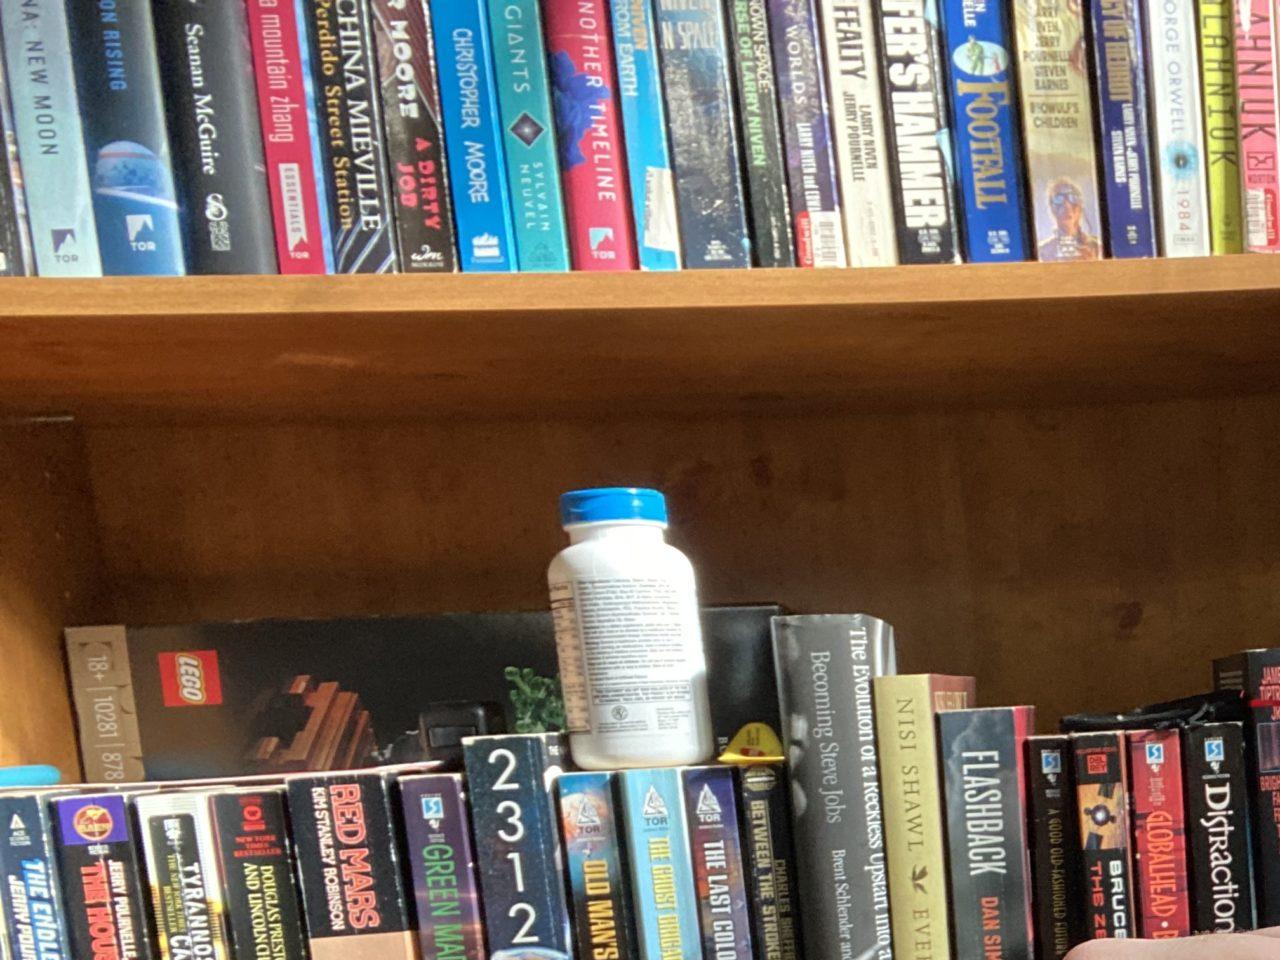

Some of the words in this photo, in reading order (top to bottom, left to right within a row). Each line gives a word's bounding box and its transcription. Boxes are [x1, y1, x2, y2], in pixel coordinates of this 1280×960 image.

[25, 41, 49, 85] NEW
[103, 30, 127, 91] RISING
[185, 23, 205, 88] Seanan
[260, 14, 290, 89] mountain
[335, 0, 366, 90] CHINA
[390, 20, 419, 118] MOORE
[504, 5, 531, 94] GIANTS
[577, 1, 605, 88] NOTHER
[786, 24, 807, 105] WORLDS
[834, 6, 867, 80] FEALTY
[453, 28, 481, 129] CHRISTOPHER
[619, 44, 639, 97] EARTH
[741, 61, 759, 115] LARRY
[1168, 61, 1184, 133] ORWELL
[33, 95, 58, 155] MOON
[269, 96, 299, 143] zhang
[325, 85, 342, 147] Street
[842, 91, 858, 122] JERRY
[859, 104, 873, 137] LARRY
[1033, 117, 1079, 129] CHILDREN
[194, 93, 220, 175] McGuire
[588, 103, 617, 202] TIMELINE
[749, 117, 767, 167] NIVEN
[797, 123, 813, 148] LARRY
[847, 125, 865, 182] POURNELLE
[865, 141, 878, 169] NIVEN
[891, 91, 947, 228] HAMMER
[956, 78, 1010, 210] FOOTFALL
[347, 100, 381, 231] MIÉVILLE
[464, 141, 490, 204] MOORE
[801, 149, 817, 173] NIVEN
[284, 167, 302, 234] ESSENTIALS
[333, 157, 353, 229] Station
[418, 160, 441, 230] DIRTY
[520, 164, 536, 229] NEUVEL
[532, 161, 549, 231] SYLVAIN
[1177, 190, 1191, 231] 1984
[1266, 193, 1276, 240] Goodwill
[800, 218, 812, 265] Goodwill
[88, 656, 108, 681] 18+
[849, 627, 869, 660] The
[177, 655, 203, 703] LEGO
[810, 651, 836, 738] Becoming
[94, 696, 117, 738] 10281
[896, 698, 917, 751] NISI
[102, 753, 125, 781] 878
[819, 742, 840, 785] Steve
[311, 787, 327, 809] KIM
[330, 783, 366, 845] RED
[699, 813, 721, 822] TOR
[819, 787, 846, 824] Jobs
[901, 766, 925, 852] SHAWL
[961, 750, 1008, 876] FLASHBACK
[314, 811, 336, 864] STANLEY
[647, 837, 670, 861] THE
[703, 840, 725, 872] THE
[750, 800, 772, 868] BETWEEN
[1050, 817, 1062, 845] GOOD
[23, 858, 47, 897] THE
[81, 863, 111, 906] THE
[108, 859, 126, 895] JERRY
[242, 863, 257, 889] AND
[341, 847, 380, 930] MARS
[422, 842, 460, 917] GREEN
[582, 859, 610, 895] OLD
[651, 863, 677, 911] GHOST
[757, 873, 776, 901] THE
[832, 849, 847, 881] Brent
[1051, 846, 1067, 919] OLD-FASHIONED
[1090, 861, 1104, 906] THE
[1146, 811, 1177, 917] GLOBALHEAD
[247, 893, 266, 943] LINCOLN
[260, 865, 281, 920] DOUGLAS
[321, 867, 345, 931] ROBINSON
[706, 875, 731, 916] LAST
[836, 883, 854, 940] Schlender
[980, 897, 999, 932] DAN
[588, 900, 619, 960] MAN'S
